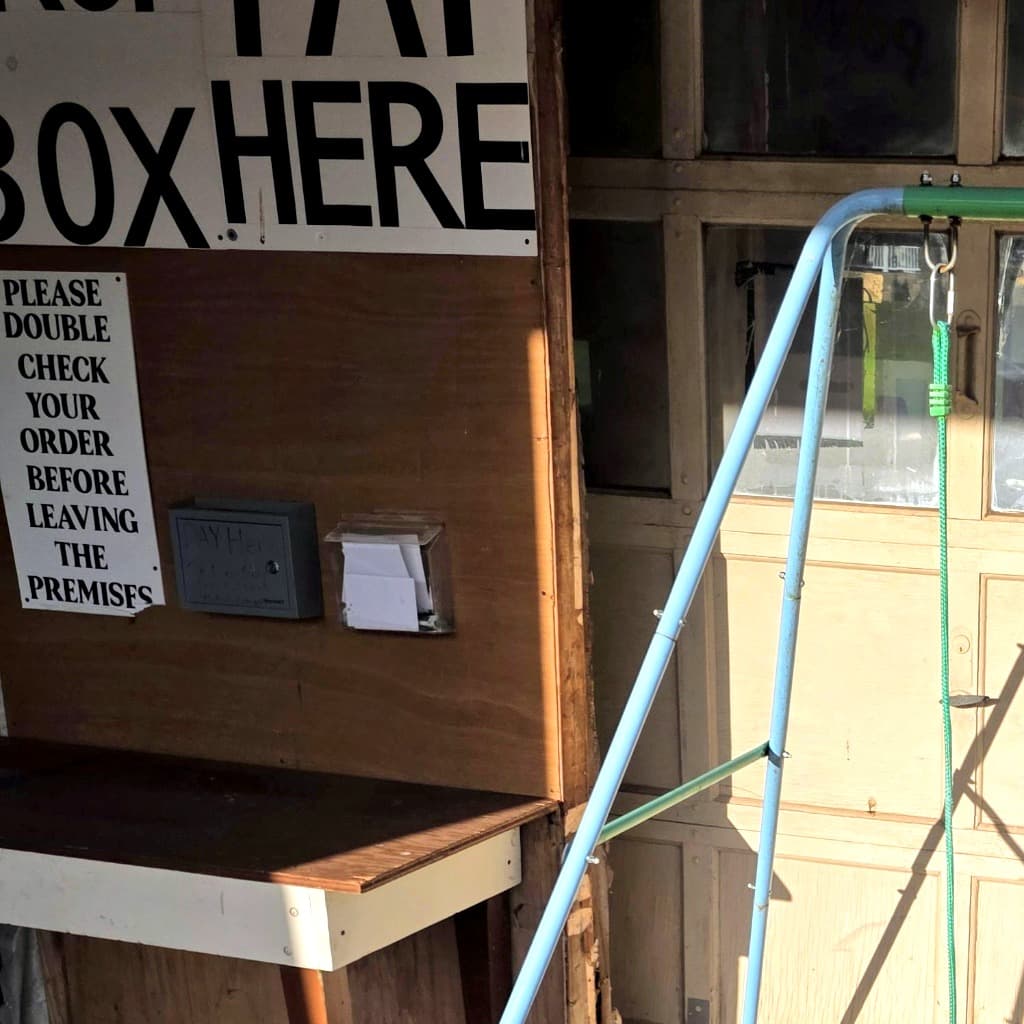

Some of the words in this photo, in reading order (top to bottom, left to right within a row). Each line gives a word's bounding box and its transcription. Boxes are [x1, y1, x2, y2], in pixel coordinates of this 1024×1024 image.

[211, 80, 536, 230] HERE
[3, 279, 102, 307] PLEASE
[3, 312, 111, 342] DOUBLE
[18, 354, 110, 384] CHECK
[25, 392, 100, 420] YOUR
[20, 428, 114, 456] ORDER
[27, 465, 129, 496] BEFORE
[26, 503, 139, 533] LEAVING
[54, 541, 108, 570] THE
[28, 575, 153, 609] PREMISES
